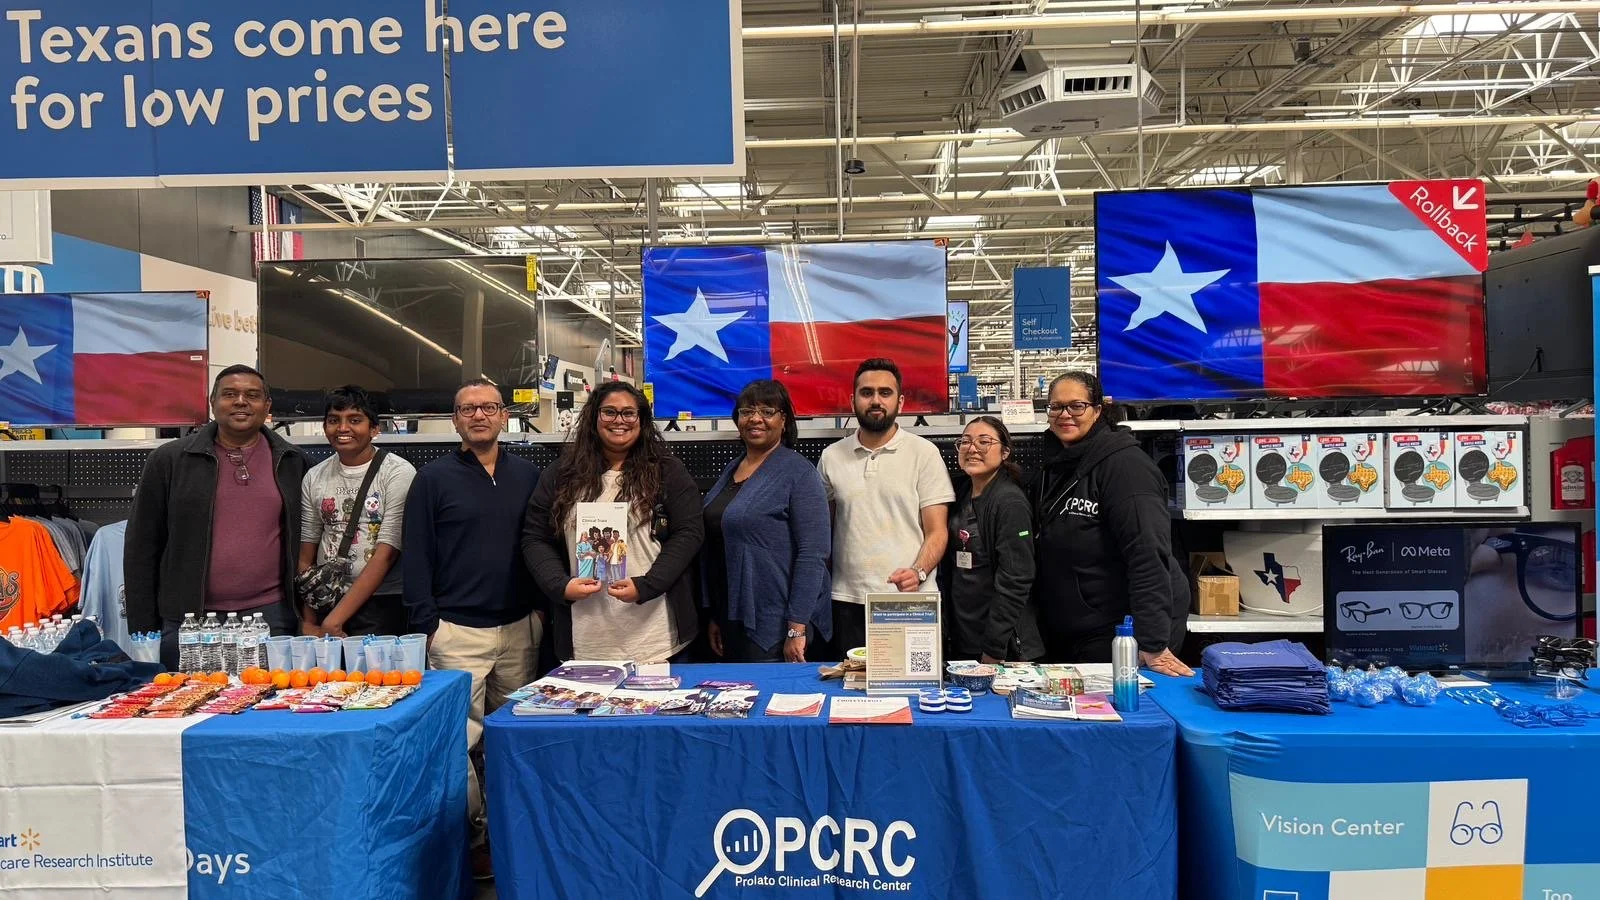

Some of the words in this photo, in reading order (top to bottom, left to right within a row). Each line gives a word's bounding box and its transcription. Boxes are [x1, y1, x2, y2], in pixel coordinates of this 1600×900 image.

[6, 9, 214, 64] Texans
[233, 16, 404, 59] come
[425, 0, 569, 53] here
[10, 76, 105, 131] for
[123, 75, 225, 128] low
[247, 69, 433, 142] prices
[1409, 186, 1479, 253] Rollback
[209, 305, 231, 330] ive
[1022, 318, 1037, 326] Self
[1022, 327, 1058, 336] Checkout
[1070, 497, 1099, 515] PCRC
[1418, 546, 1451, 557] Meta
[1261, 813, 1324, 835] Vision
[1331, 819, 1404, 835] Center
[775, 815, 917, 877] PCRC
[34, 853, 94, 868] Research
[96, 853, 153, 868] Institute
[735, 875, 776, 887] Prolato
[778, 875, 820, 887] Clinical
[873, 880, 912, 891] Center
